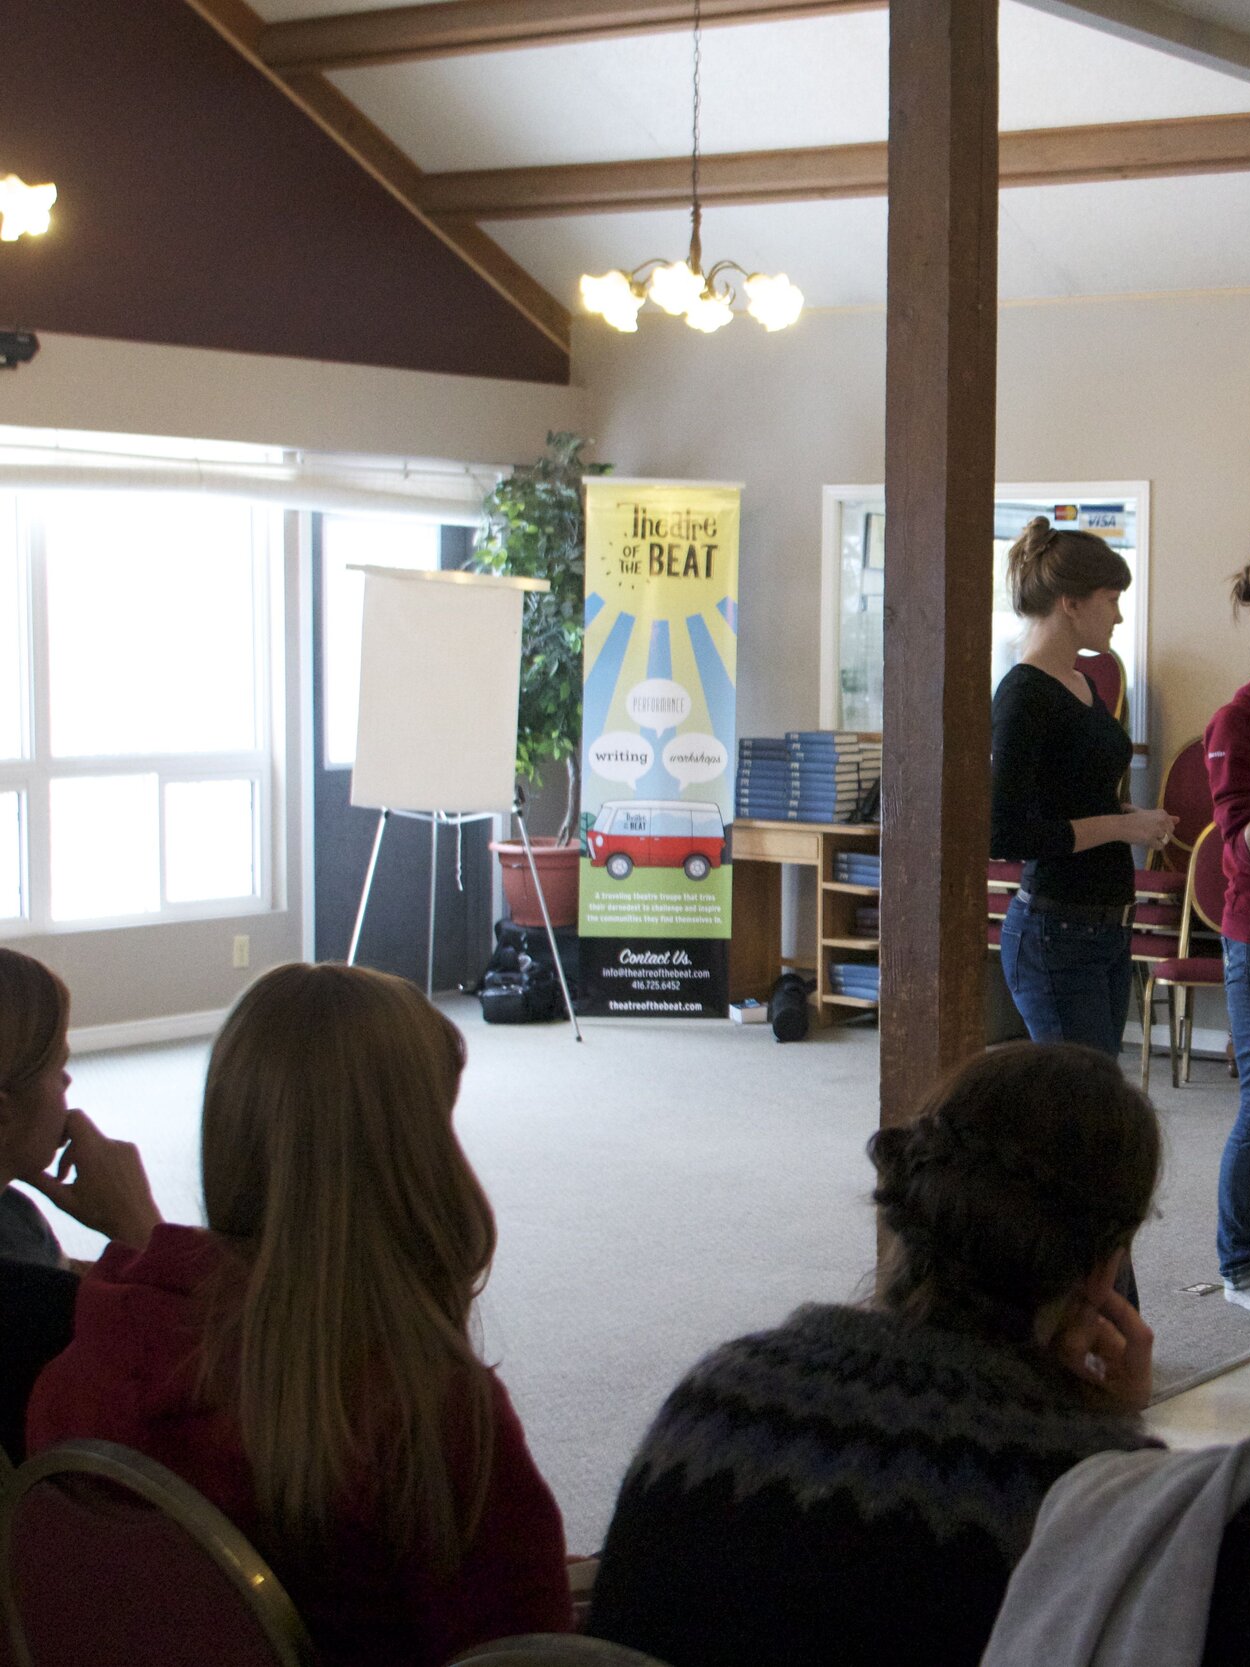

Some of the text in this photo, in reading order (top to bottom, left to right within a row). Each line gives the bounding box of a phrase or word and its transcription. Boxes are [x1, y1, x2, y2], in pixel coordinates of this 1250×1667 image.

[616, 503, 717, 540] Theatre
[1088, 514, 1117, 528] VISA
[622, 545, 640, 558] OF
[619, 559, 642, 574] THE
[648, 542, 719, 578] BEAT
[633, 696, 685, 713] PERFORMANCE
[595, 750, 648, 765] writing
[669, 751, 721, 766] workshops
[620, 948, 692, 965] Contact Us.
[602, 967, 710, 978] info@theatreofthebeat.com
[632, 980, 680, 990] 416.725.6452
[609, 1000, 702, 1011] theatreofthebeat.com
